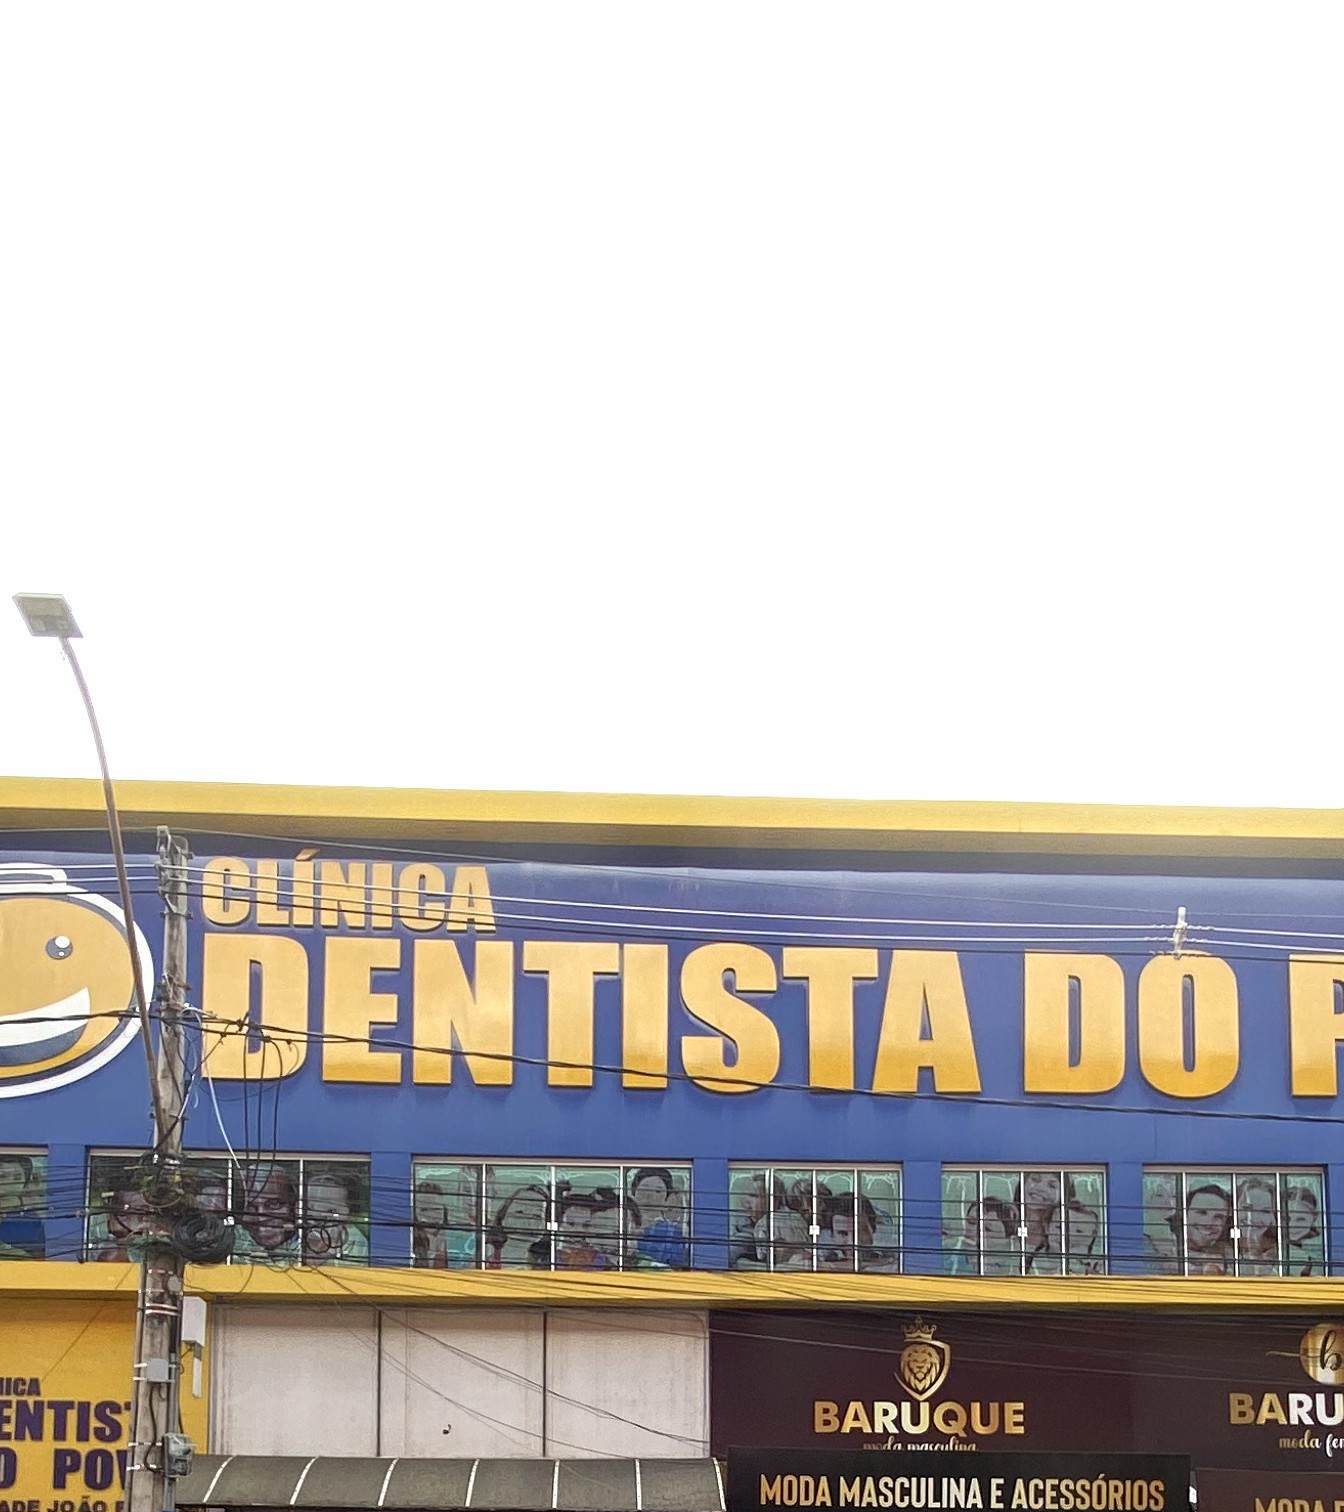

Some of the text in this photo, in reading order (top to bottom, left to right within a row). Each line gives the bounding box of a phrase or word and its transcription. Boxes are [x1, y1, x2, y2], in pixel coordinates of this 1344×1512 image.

[201, 848, 497, 934] CLÍNICA
[201, 933, 982, 1095] DENTISTA
[1023, 949, 1239, 1098] DO
[814, 1401, 1025, 1436] BARUQUE
[1279, 1430, 1321, 1449] moda
[760, 1474, 1166, 1512] MODA MASCULINA E ACESSÓRIOS
